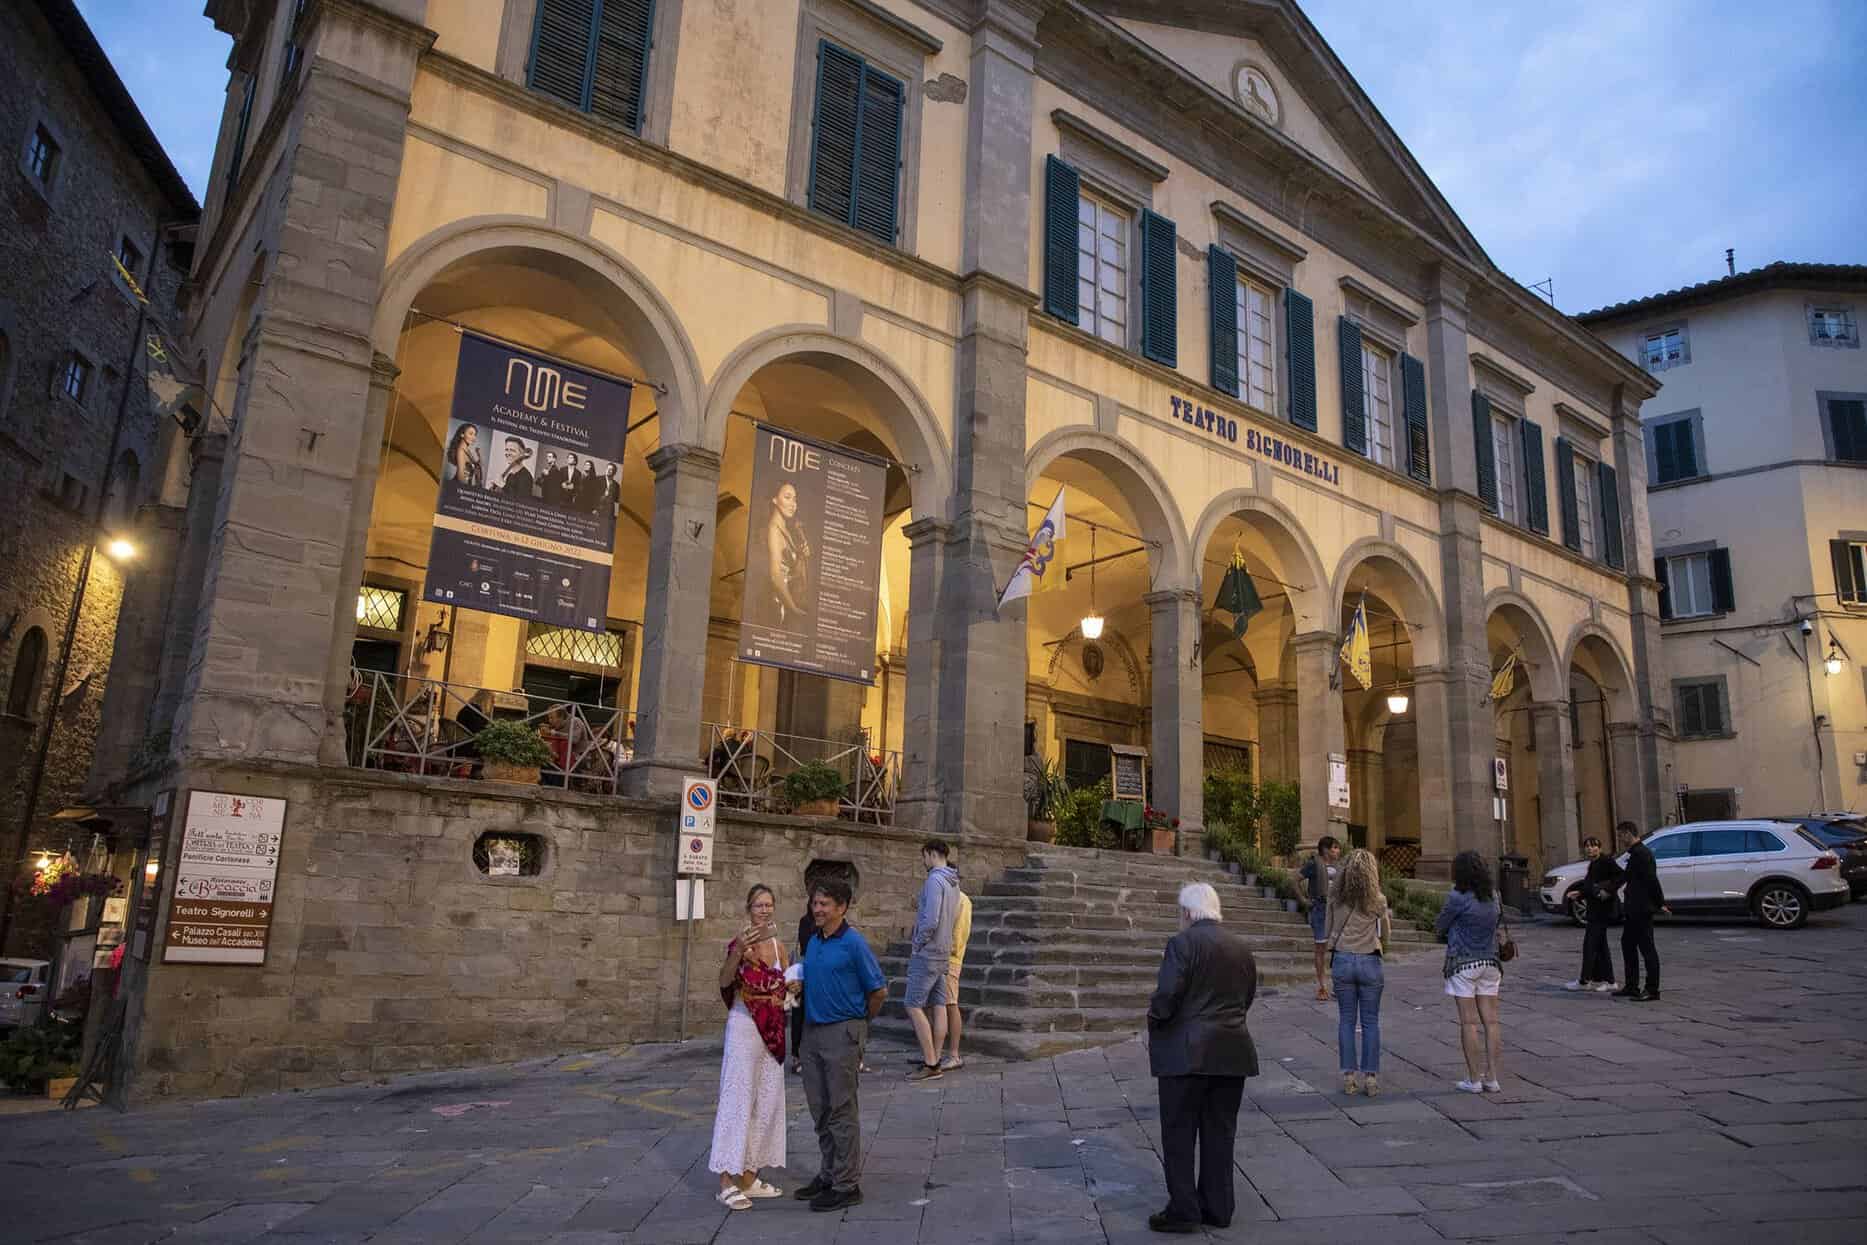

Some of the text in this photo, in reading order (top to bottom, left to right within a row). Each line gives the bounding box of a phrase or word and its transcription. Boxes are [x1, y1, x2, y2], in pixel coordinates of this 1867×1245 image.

[492, 403, 538, 424] ACADEMY
[551, 420, 590, 439] FESTIVAL
[1170, 395, 1339, 485] TEATRO SIGNORELLI
[176, 905, 254, 918] Teatro Signorelli
[183, 926, 215, 936] Palazzo
[216, 927, 241, 936] Casali
[182, 935, 208, 944] Museo
